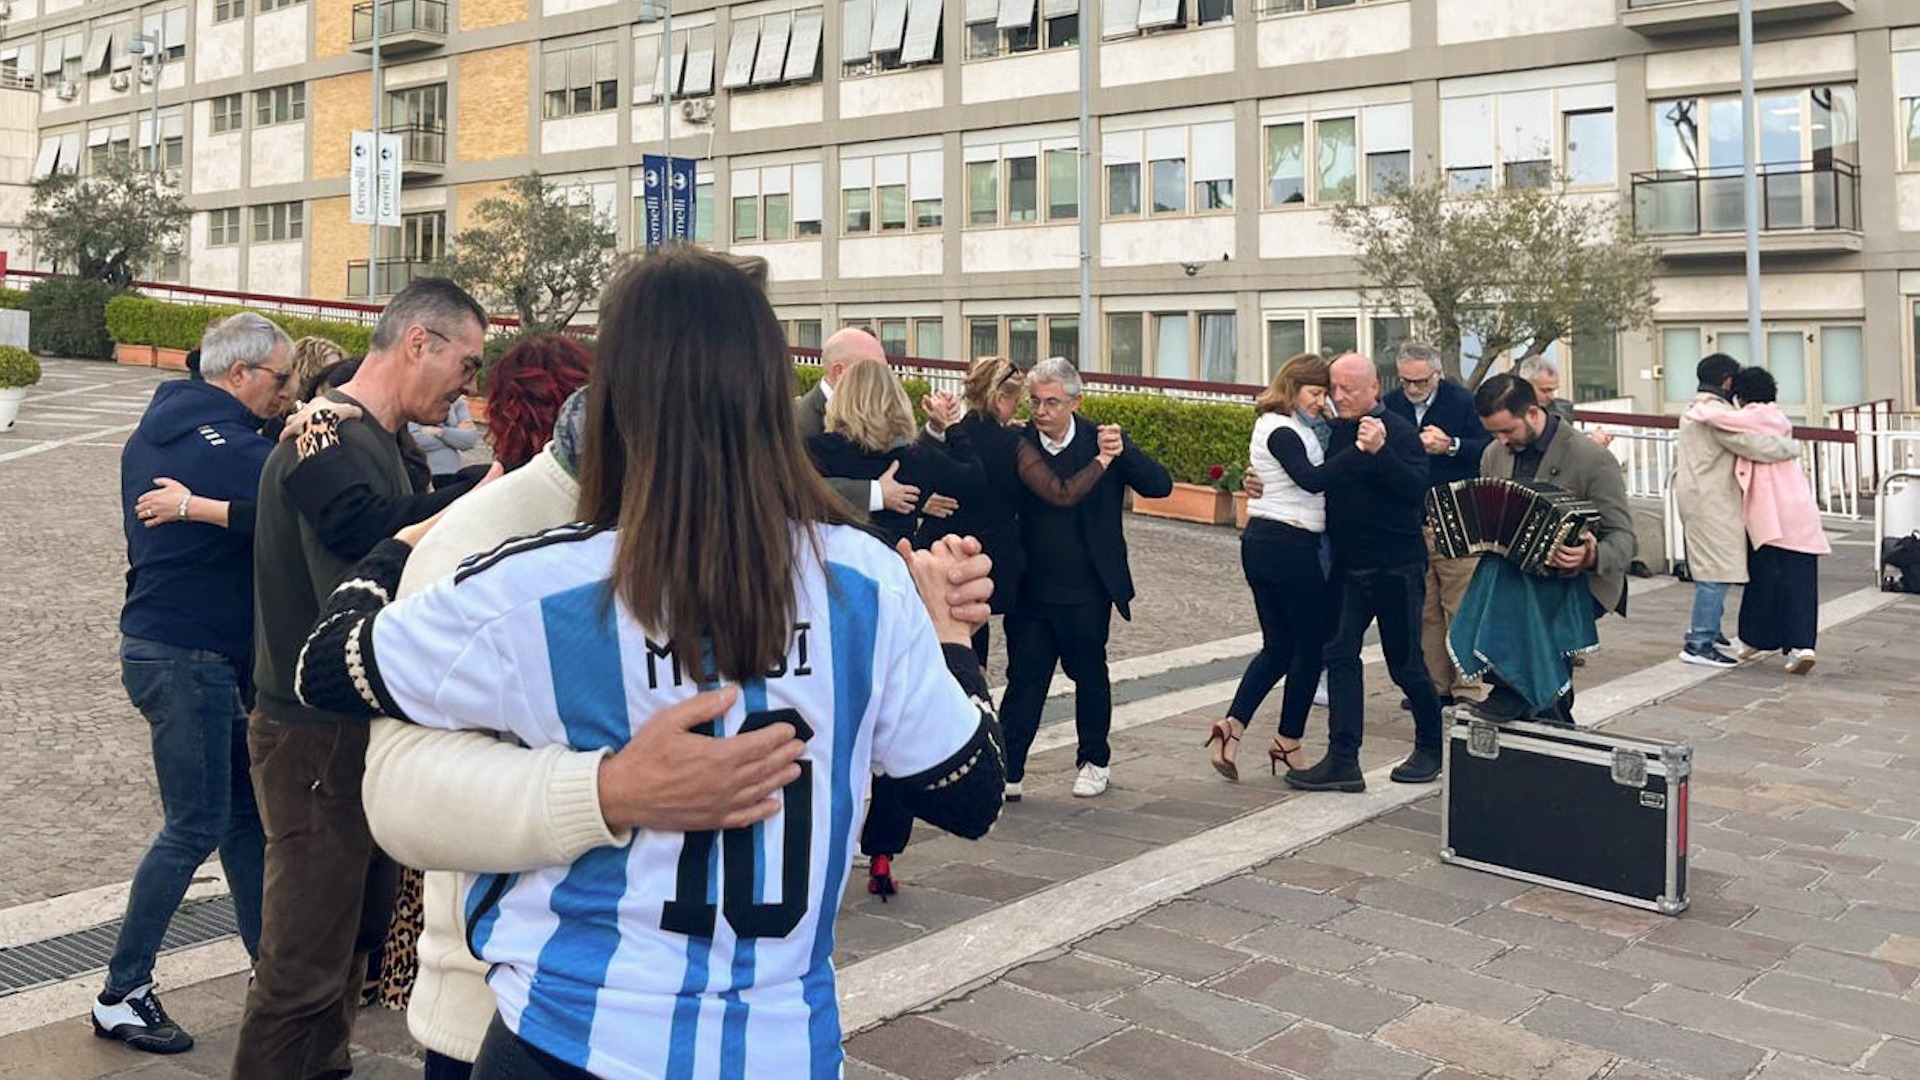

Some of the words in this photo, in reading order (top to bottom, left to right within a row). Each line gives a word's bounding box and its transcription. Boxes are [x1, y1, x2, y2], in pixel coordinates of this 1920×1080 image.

[354, 166, 366, 214] Gemelli
[380, 169, 391, 217] Gemelli
[673, 198, 686, 242] emelli
[659, 707, 815, 938] 10
